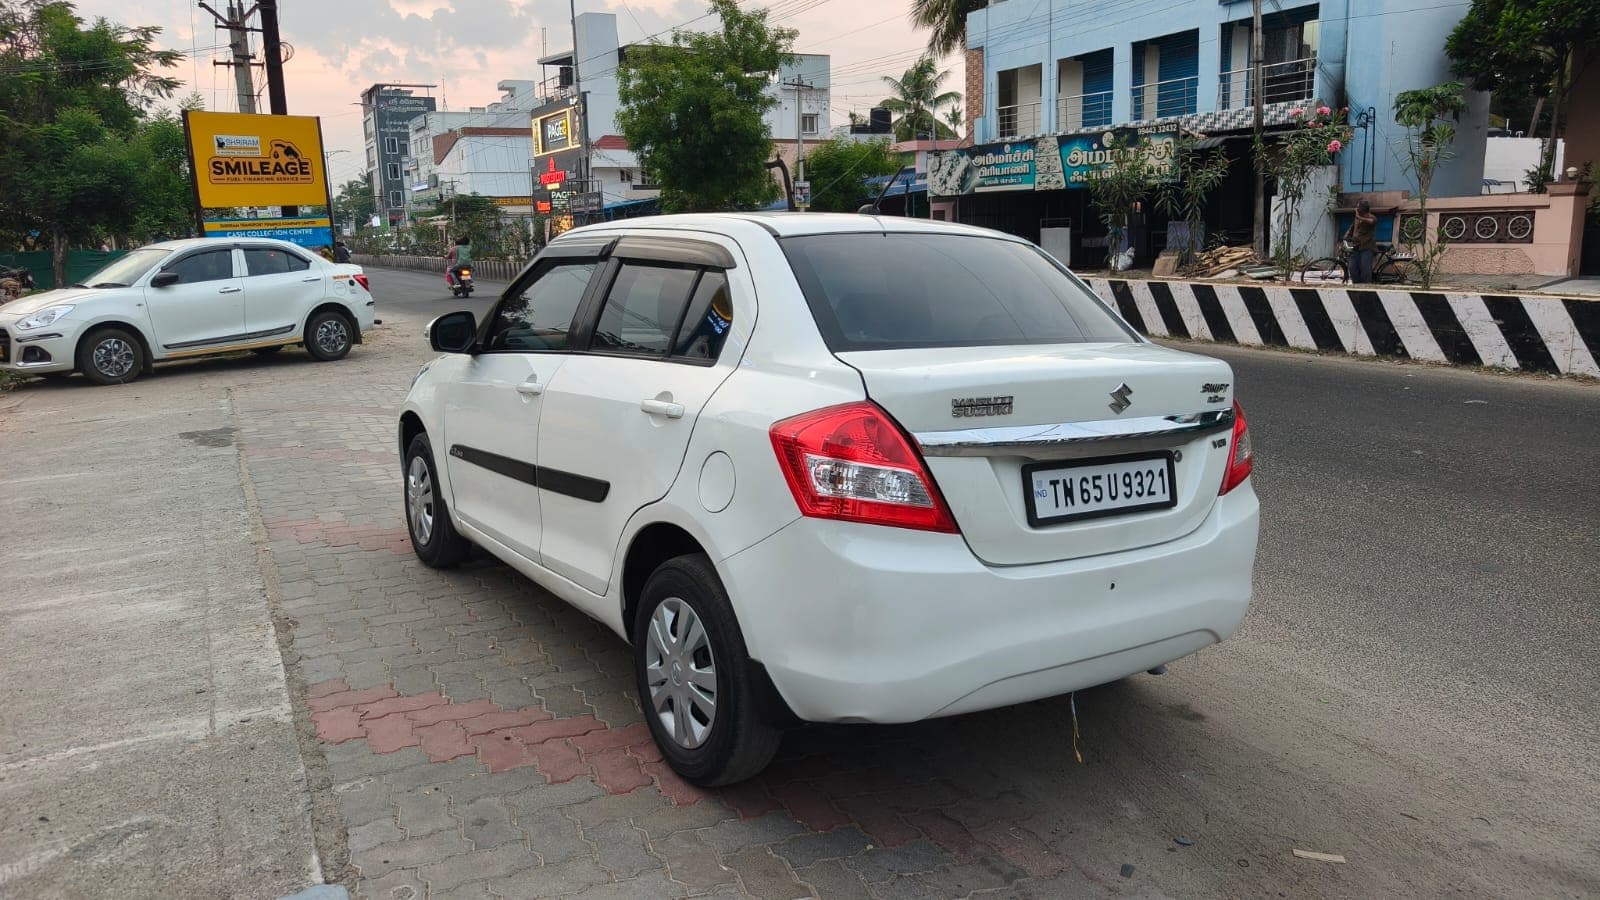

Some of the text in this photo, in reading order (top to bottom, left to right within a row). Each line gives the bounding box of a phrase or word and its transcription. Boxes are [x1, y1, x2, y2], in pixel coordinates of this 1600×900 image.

[212, 160, 310, 176] SMILEAGE
[247, 229, 288, 237] COLLECTION
[289, 228, 313, 236] CENTRE
[1200, 383, 1230, 393] SWIFT
[952, 396, 1014, 407] MARUTI
[952, 405, 1014, 418] SUZUKI
